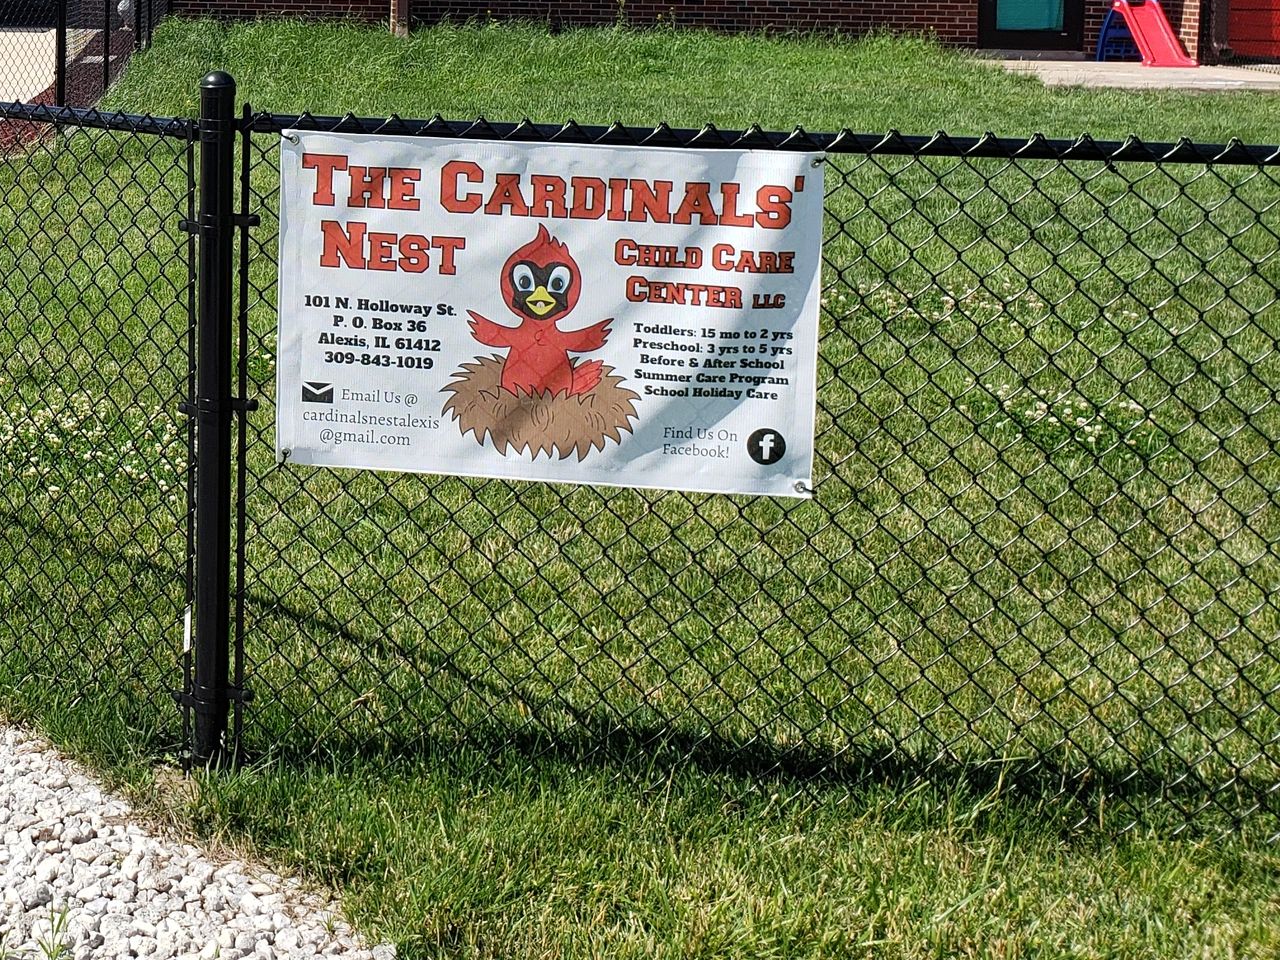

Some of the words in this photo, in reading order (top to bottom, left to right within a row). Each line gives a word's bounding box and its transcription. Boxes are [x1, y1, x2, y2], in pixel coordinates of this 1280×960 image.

[302, 153, 422, 211] THE
[440, 160, 805, 230] CARDINALS'
[320, 220, 466, 275] NEST
[614, 238, 703, 269] CHILD
[712, 243, 795, 274] CARE
[625, 275, 743, 309] CENTER
[752, 294, 786, 309] LLC
[304, 295, 330, 308] 101
[335, 297, 352, 310] N.
[357, 298, 432, 317] Holloway
[436, 303, 457, 316] St.
[333, 315, 347, 328] P.
[352, 316, 367, 329] O.
[372, 318, 402, 331] Box
[407, 320, 427, 333] 36
[633, 322, 697, 337] Toddlers:
[701, 328, 716, 338] 15
[719, 331, 740, 340] mo
[744, 330, 757, 340] to
[760, 329, 769, 339] 2
[771, 331, 794, 343] yrs
[318, 332, 369, 349] Alexis,
[374, 336, 390, 349] IL
[395, 338, 441, 352] 61412
[632, 338, 703, 353] Preschool:
[706, 343, 715, 353] 3
[718, 345, 739, 356] yrs
[742, 344, 756, 354] to
[759, 344, 768, 354] 5
[770, 346, 793, 357] yrs
[324, 351, 434, 370] 309-843-1019
[640, 353, 685, 367] Before
[688, 358, 699, 368] &
[702, 358, 737, 369] After
[739, 358, 785, 370] School
[634, 369, 692, 383] Summer
[696, 373, 726, 383] Care
[729, 373, 789, 386] Program
[341, 389, 380, 403] Email
[384, 391, 401, 404] Us
[404, 393, 418, 407] @
[644, 385, 689, 398] School
[692, 387, 743, 400] Holiday
[746, 389, 778, 401] Care
[303, 408, 440, 429] cardinalsnestalexis
[319, 428, 411, 446] @gmail.com
[663, 426, 693, 439] Find
[696, 428, 714, 440] Us
[717, 429, 738, 442] On
[662, 443, 730, 459] Facebook!
